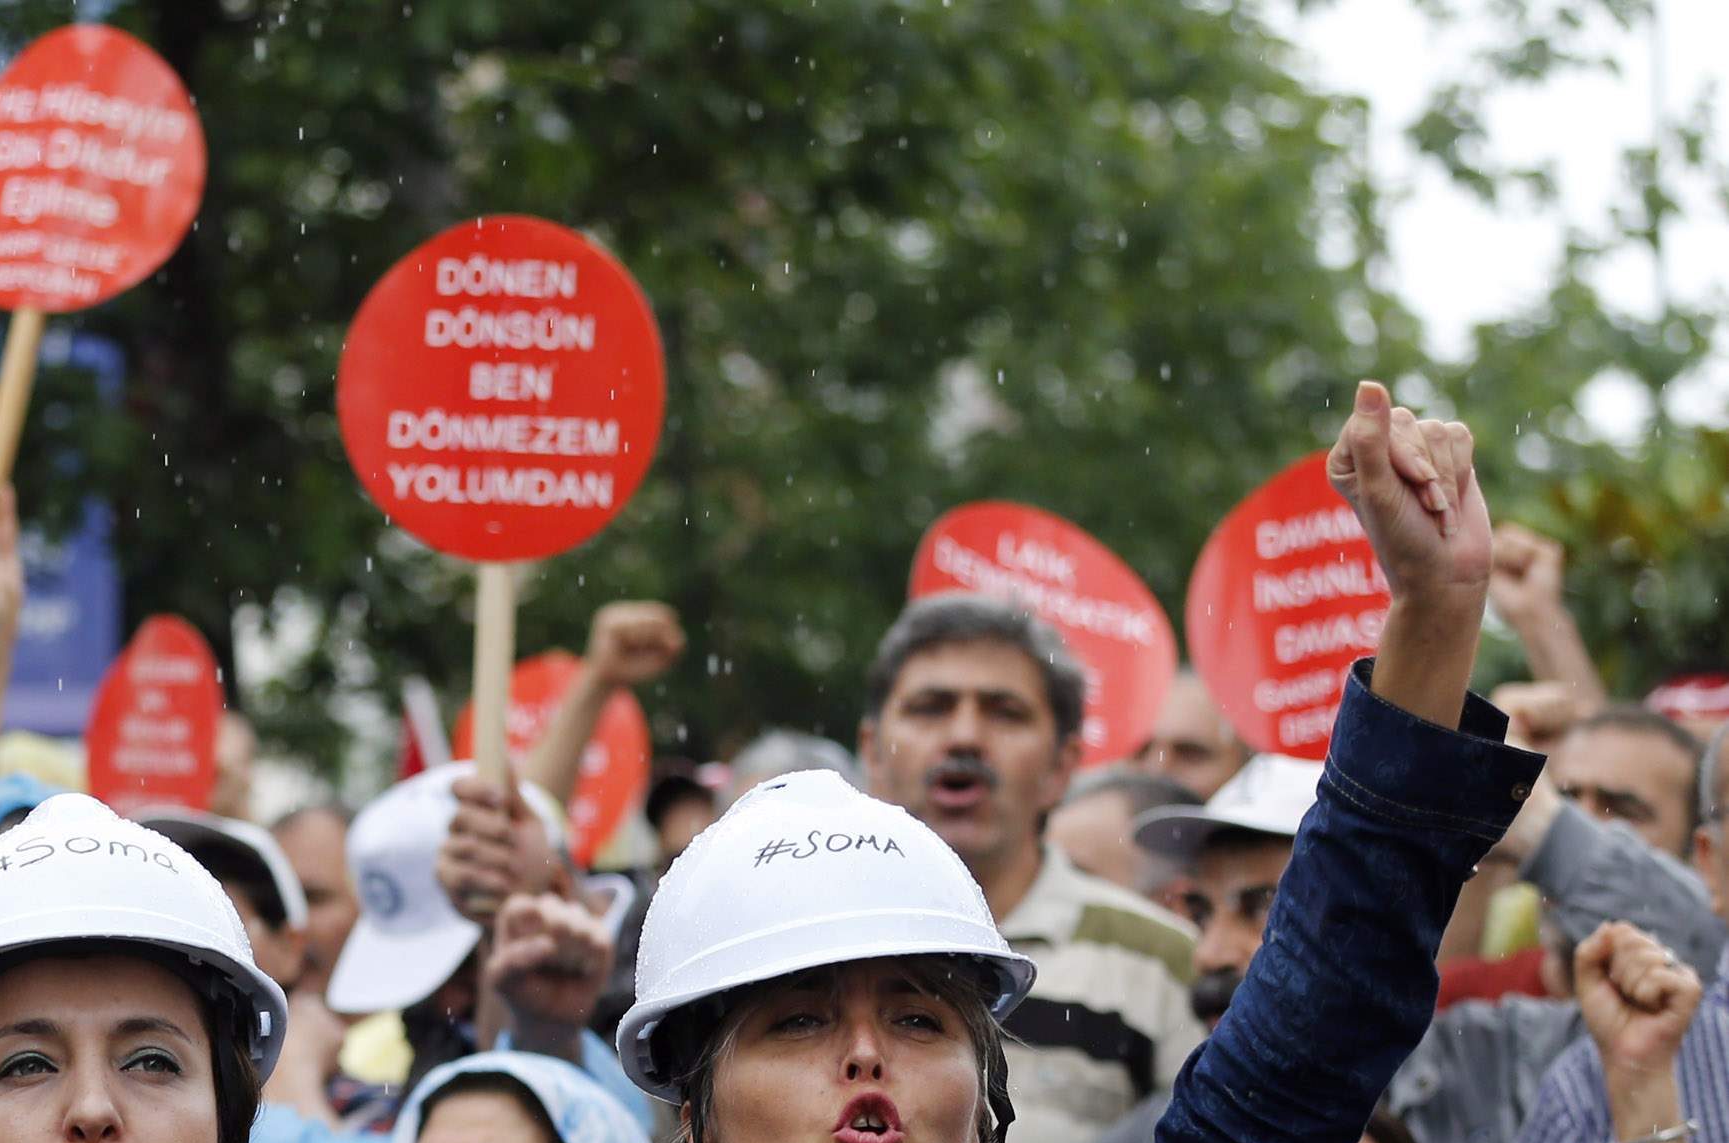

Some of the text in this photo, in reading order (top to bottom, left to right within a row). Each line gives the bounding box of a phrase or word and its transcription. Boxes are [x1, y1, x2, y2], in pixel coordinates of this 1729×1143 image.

[436, 254, 577, 299] DÖNEN
[425, 306, 595, 351] DÖNSÜN
[469, 362, 553, 401] BEN
[387, 408, 619, 457] DÖNMEZEM
[387, 464, 614, 508] YOLUMDAN
[1274, 611, 1387, 664] DAVAS
[754, 830, 905, 867] #SOMA
